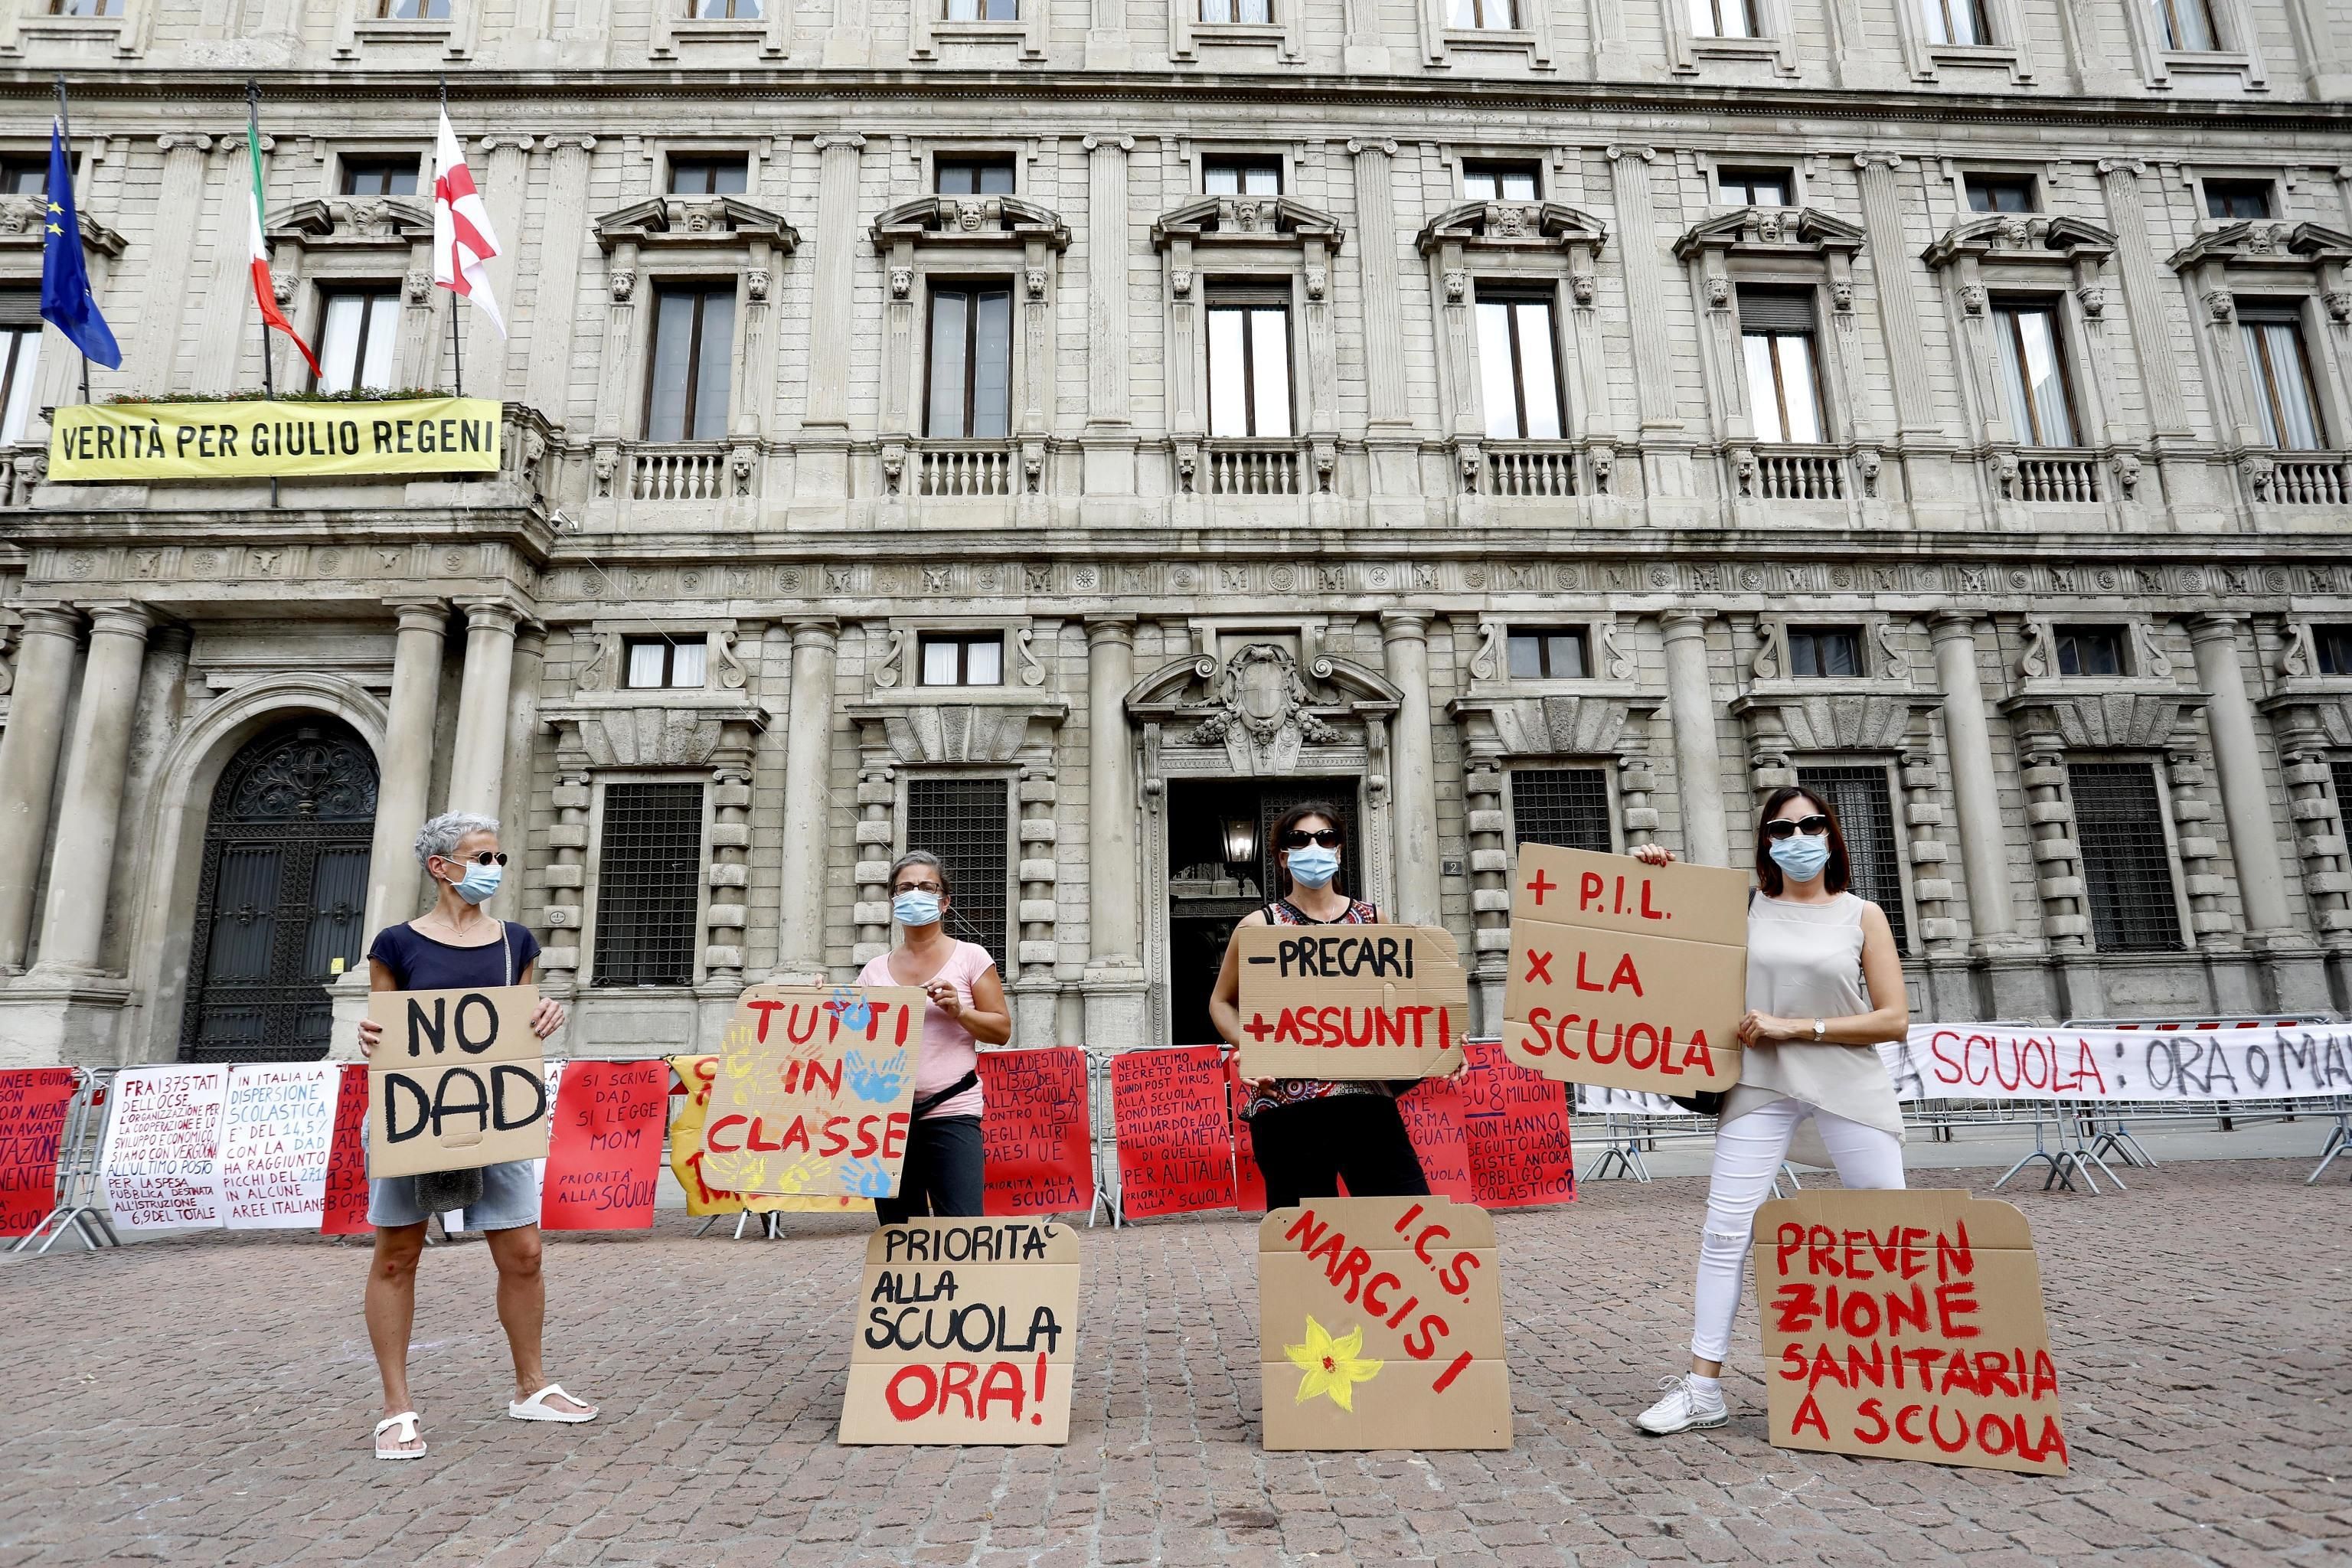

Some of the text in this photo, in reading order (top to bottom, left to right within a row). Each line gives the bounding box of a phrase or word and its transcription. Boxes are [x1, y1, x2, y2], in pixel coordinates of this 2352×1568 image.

[62, 419, 492, 459] VERITÀ PER GIULIO REGENI
[1450, 863, 1457, 872] 2
[1579, 871, 1672, 920] P.I.L.
[1576, 951, 1644, 998] LA
[407, 993, 499, 1057] NO
[746, 1000, 910, 1047] TUTTI
[1521, 1007, 1715, 1077] SCUOLA
[1027, 1051, 1080, 1070] DESTINA
[1119, 1067, 1172, 1082] DECRETO
[1178, 1059, 1223, 1073] RILANCIO
[2146, 1036, 2239, 1095] ORA
[2246, 1044, 2270, 1089] O
[125, 1074, 218, 1096] FRA STATI
[239, 1070, 324, 1086] IN ITALIA LA
[582, 1070, 658, 1087] SI SCRIVE
[784, 1058, 843, 1100] IN
[991, 1077, 1006, 1091] IL
[1039, 1073, 1060, 1086] DEL
[1062, 1068, 1084, 1088] PIL
[1116, 1073, 1214, 1096] QUINDI POST VIRUS,
[1488, 1067, 1544, 1082] STUDEN
[231, 1083, 319, 1105] DISPERSIONE
[384, 1065, 547, 1144] DAD
[596, 1091, 630, 1103] DAD
[983, 1086, 1081, 1109] ALLA SCUOLA,
[1118, 1089, 1195, 1109] ALLA SCUOLA
[1490, 1083, 1504, 1111] 8
[1507, 1084, 1555, 1103] MILIONI
[11, 1099, 70, 1119] DI NIENTE
[119, 1103, 220, 1125] L'ORGANIZZAZIONE PER
[227, 1101, 326, 1125] SCOLASTICA
[341, 1099, 361, 1113] HA
[576, 1102, 658, 1126] SI LEGGE
[982, 1103, 1076, 1122] CONTRO IL 5%
[1116, 1107, 1148, 1122] SONO
[1151, 1096, 1216, 1118] DESTINATI
[16, 1119, 65, 1136] AVANTI
[119, 1117, 215, 1135] LA COOPERAZIONE E LO
[250, 1124, 276, 1138] DEL
[707, 1112, 910, 1159] CLASSE
[982, 1125, 1068, 1144] DEGLI ALTRI
[1119, 1125, 1128, 1137] 1
[1129, 1116, 1187, 1134] MILIARDO
[1198, 1112, 1220, 1129] 400
[1465, 1112, 1560, 1139] NON HANNO
[115, 1134, 157, 1149] SVILUPPO
[227, 1136, 325, 1159] CON LA DAD
[590, 1129, 641, 1151] MOM
[1175, 1132, 1188, 1147] LA
[1468, 1130, 1570, 1157] SEGUITO LA DAD
[111, 1142, 217, 1163] SIAMO CON VERGOGNA
[224, 1152, 325, 1175] HA RAGGIUNTO
[984, 1141, 1063, 1165] PAESI UE
[1142, 1146, 1211, 1161] DI QUELLI
[1524, 1150, 1570, 1166] ANCORA
[181, 1160, 213, 1175] POSTO
[223, 1171, 296, 1187] PICCHI DEL
[1124, 1167, 1161, 1187] PER
[1163, 1157, 1235, 1185] ALITALIA
[109, 1178, 189, 1189] PER LA SPESA
[1044, 1175, 1074, 1187] ALLA
[110, 1186, 214, 1200] PUBBLICA DESTINATA
[227, 1184, 304, 1202] IN ALCUNE
[558, 1188, 597, 1203] ALLA
[596, 1179, 656, 1210] SCUOLA
[1012, 1187, 1080, 1207] SCUOLA
[1136, 1187, 1233, 1210] ALLA SCUOLA
[132, 1207, 216, 1225] 6,9 DEL TOTALE
[232, 1197, 325, 1218] AREE ITALIANE
[1394, 1203, 1481, 1304] I.C.S.
[1776, 1218, 1975, 1283] PREVEN
[871, 1270, 959, 1303] ALLA
[1285, 1210, 1474, 1394] NARCISI
[1770, 1281, 1984, 1339] ZIONE
[864, 1303, 1062, 1354] SCUOLA
[1779, 1339, 2058, 1401] SANITARIA
[885, 1352, 1047, 1426] ORA!
[1792, 1392, 2067, 1466] A SCUOLA
